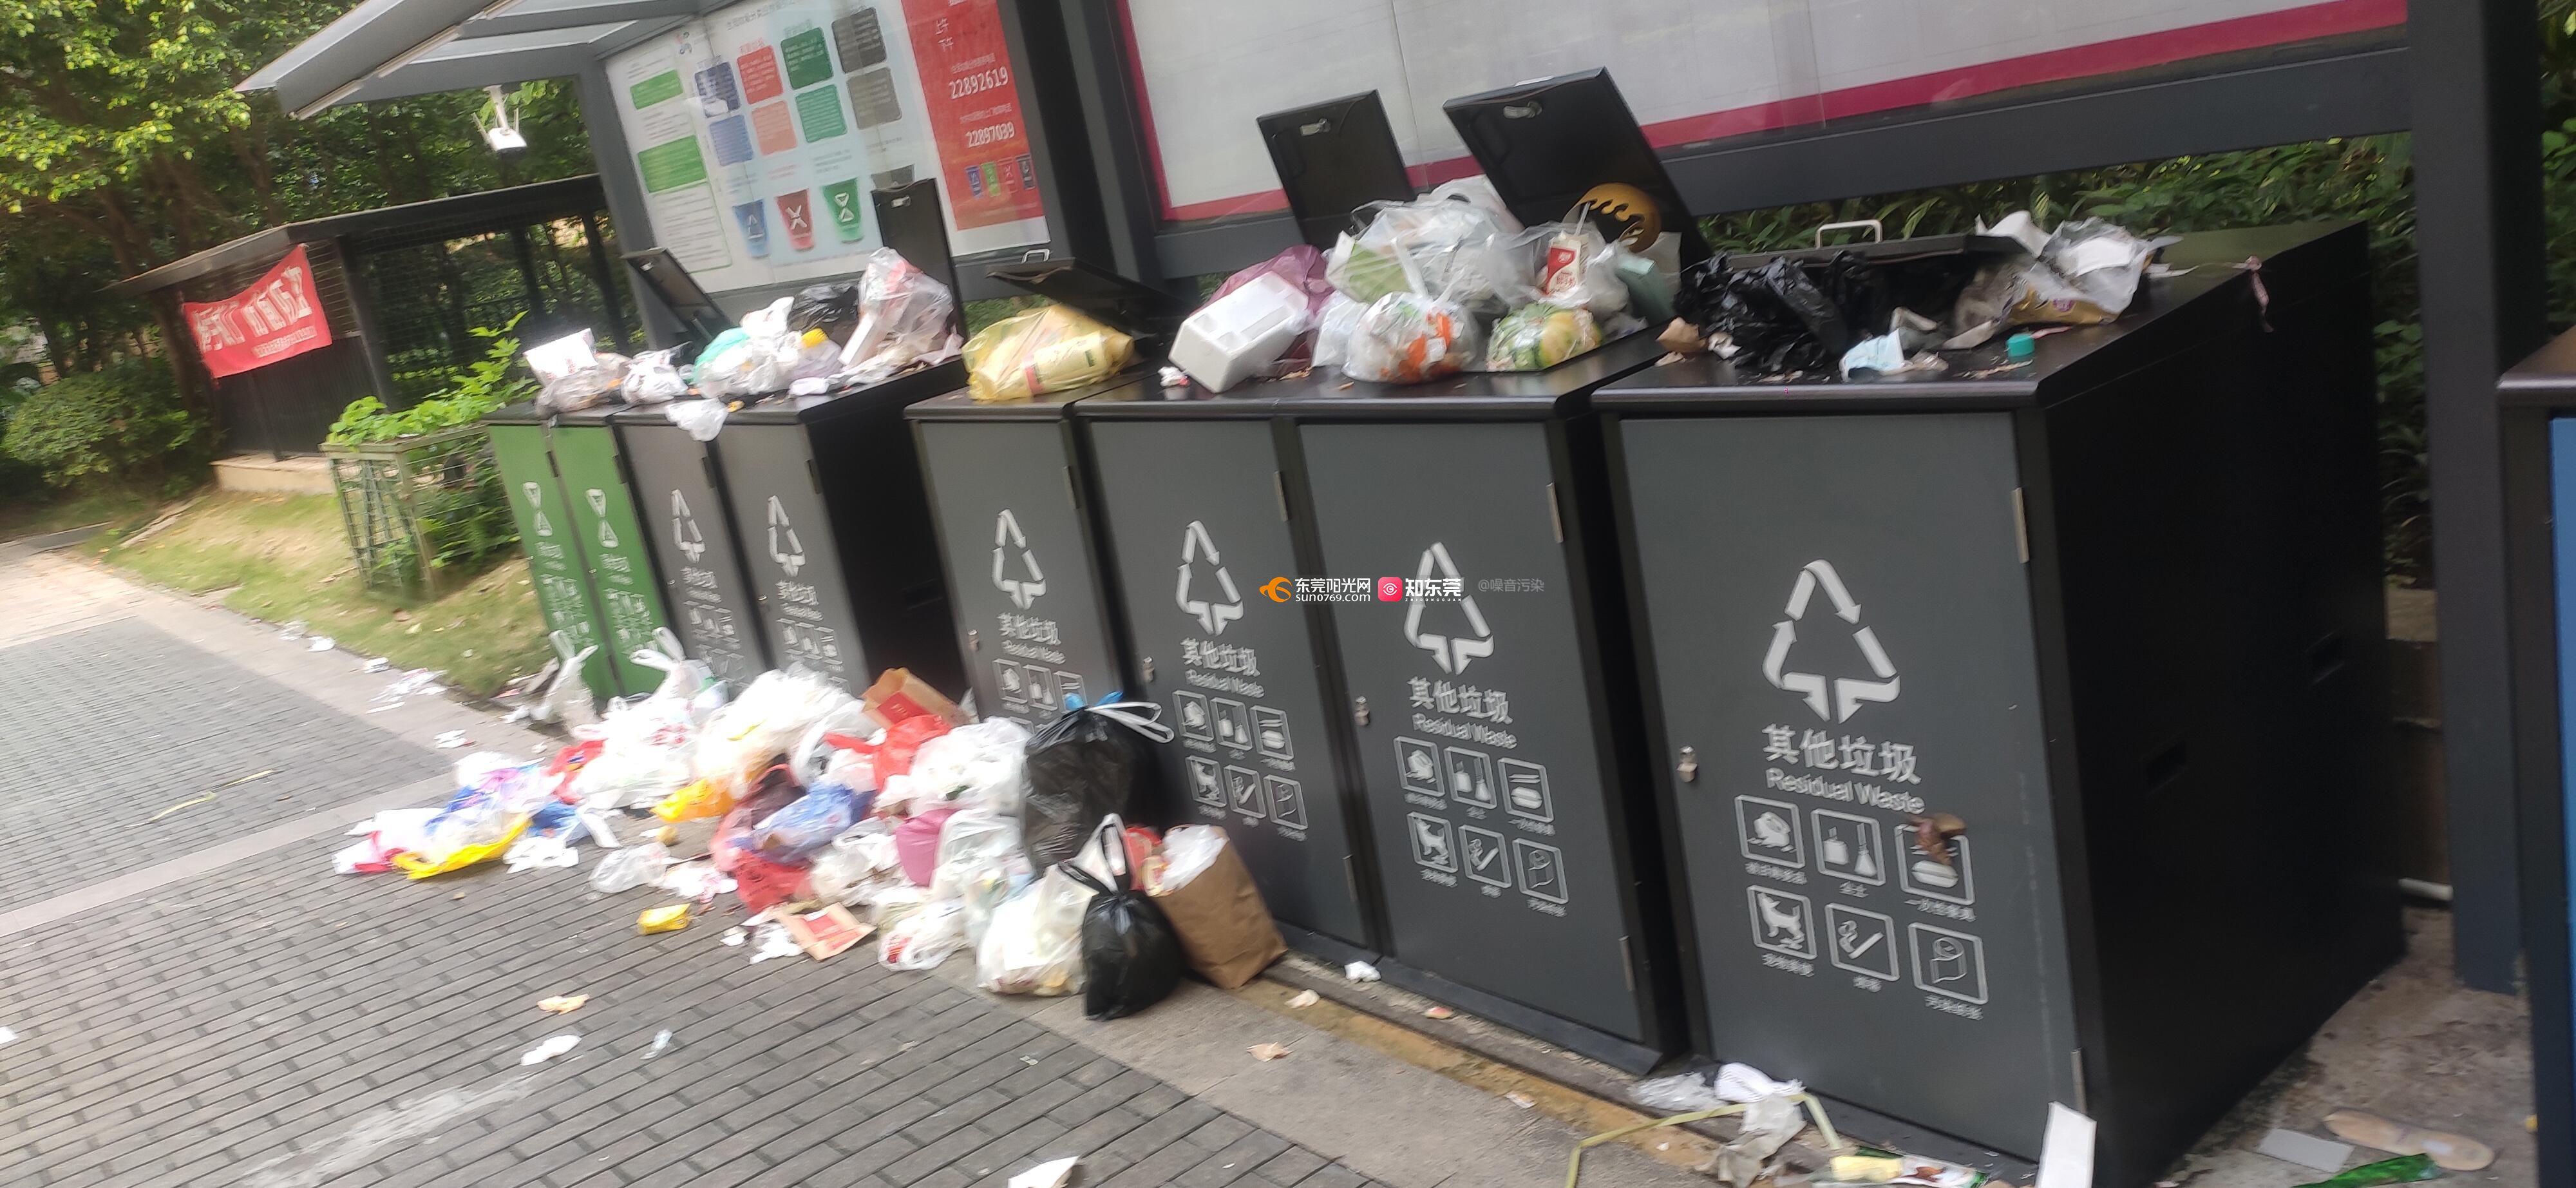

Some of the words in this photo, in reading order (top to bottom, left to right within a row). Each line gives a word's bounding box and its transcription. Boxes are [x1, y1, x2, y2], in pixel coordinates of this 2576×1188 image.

[949, 66, 1008, 99] 22892619
[965, 121, 1015, 148] 22897039
[1180, 637, 1261, 676] 其他垃圾
[1406, 676, 1514, 725] 其他垃圾
[1762, 723, 1921, 785] 其他垃圾
[1766, 768, 1853, 803] Residual
[1854, 783, 1926, 814] Waste
